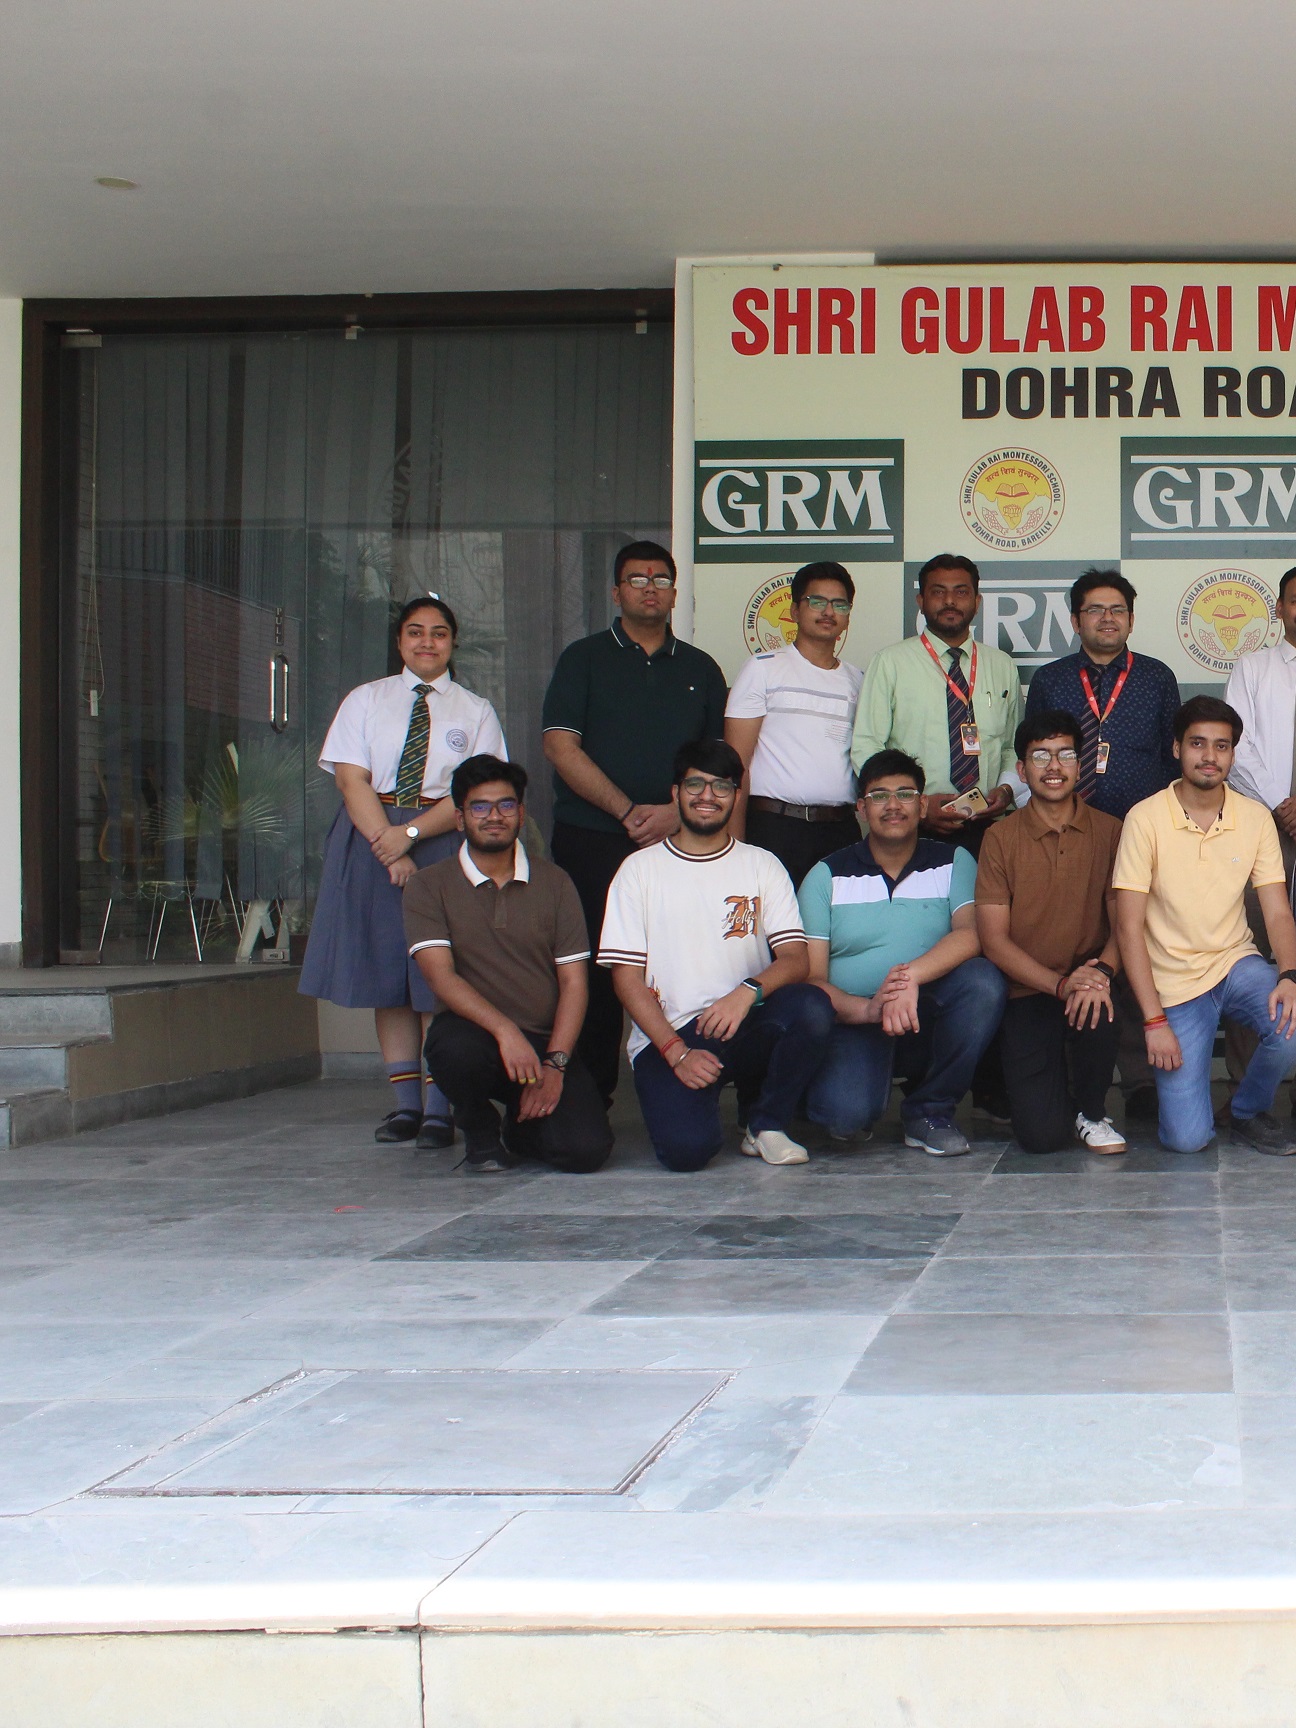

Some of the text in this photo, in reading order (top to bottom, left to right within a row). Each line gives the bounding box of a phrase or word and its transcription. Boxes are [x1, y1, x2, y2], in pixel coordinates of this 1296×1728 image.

[731, 287, 876, 355] SHRI
[901, 285, 1106, 355] GULAB
[1130, 285, 1233, 353] RAI
[961, 367, 1181, 420] DOHRA
[701, 470, 892, 533] GRM
[964, 451, 1060, 504] SHRI GULAB RAI MONTESSORI SCHOOL
[972, 522, 994, 543] DOHRA
[1022, 521, 1052, 546] BAREILLY
[752, 588, 771, 608] GULAB
[771, 578, 784, 589] RAI
[1181, 607, 1189, 625] SHRI
[1185, 583, 1204, 605] GULAB
[1204, 575, 1217, 586] RAI
[1220, 573, 1267, 595] MONTESSORI
[275, 607, 283, 644] PULL
[1189, 644, 1211, 665] DOHRA
